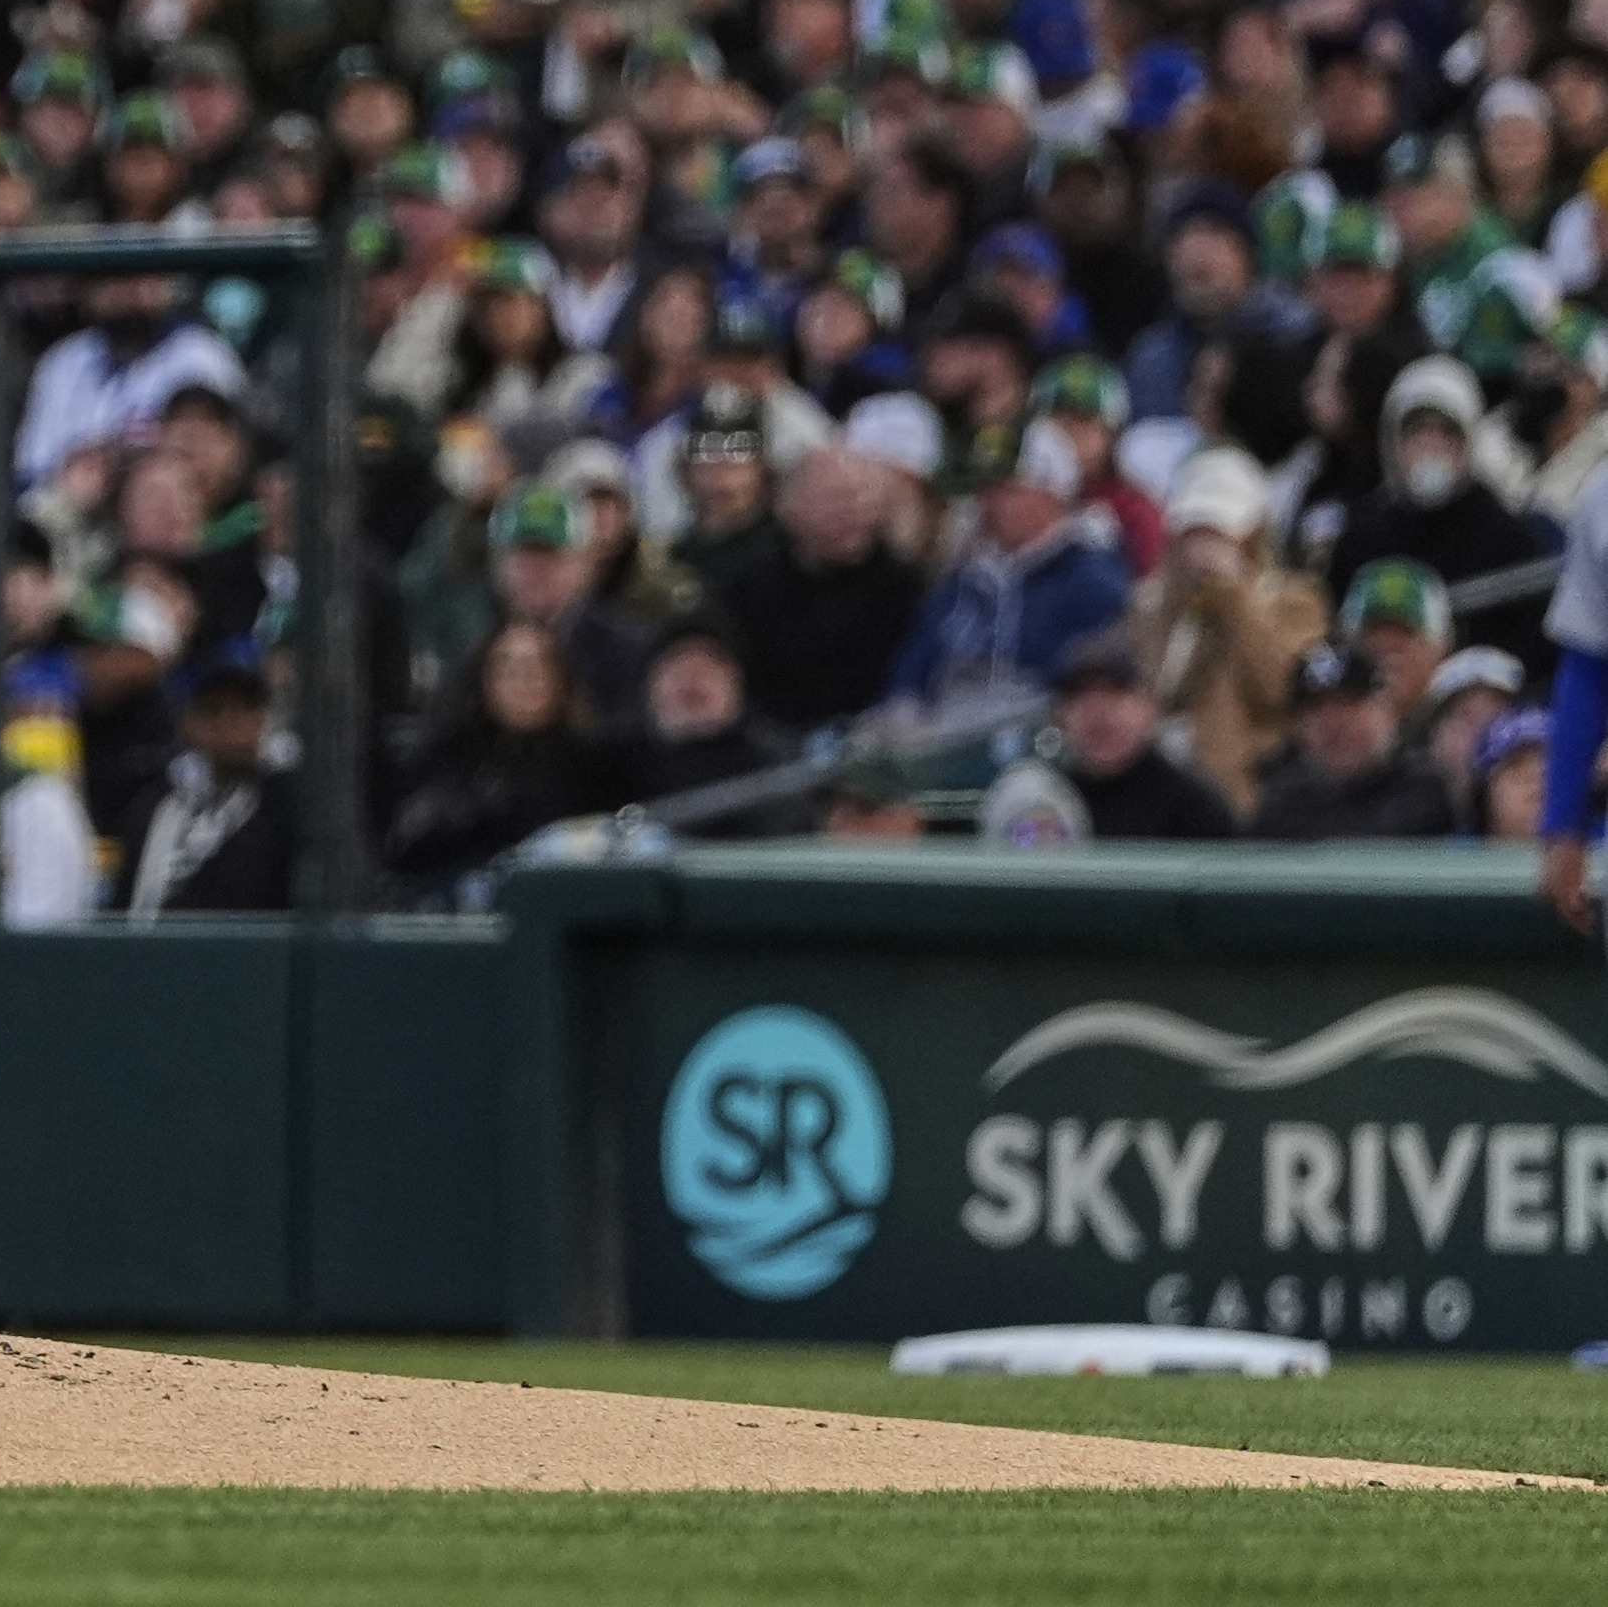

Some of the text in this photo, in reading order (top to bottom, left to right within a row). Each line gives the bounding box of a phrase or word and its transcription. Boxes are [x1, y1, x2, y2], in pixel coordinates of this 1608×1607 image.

[703, 1071, 848, 1200] SR
[962, 1115, 1226, 1262] SKY
[1145, 1273, 1474, 1342] CASINO
